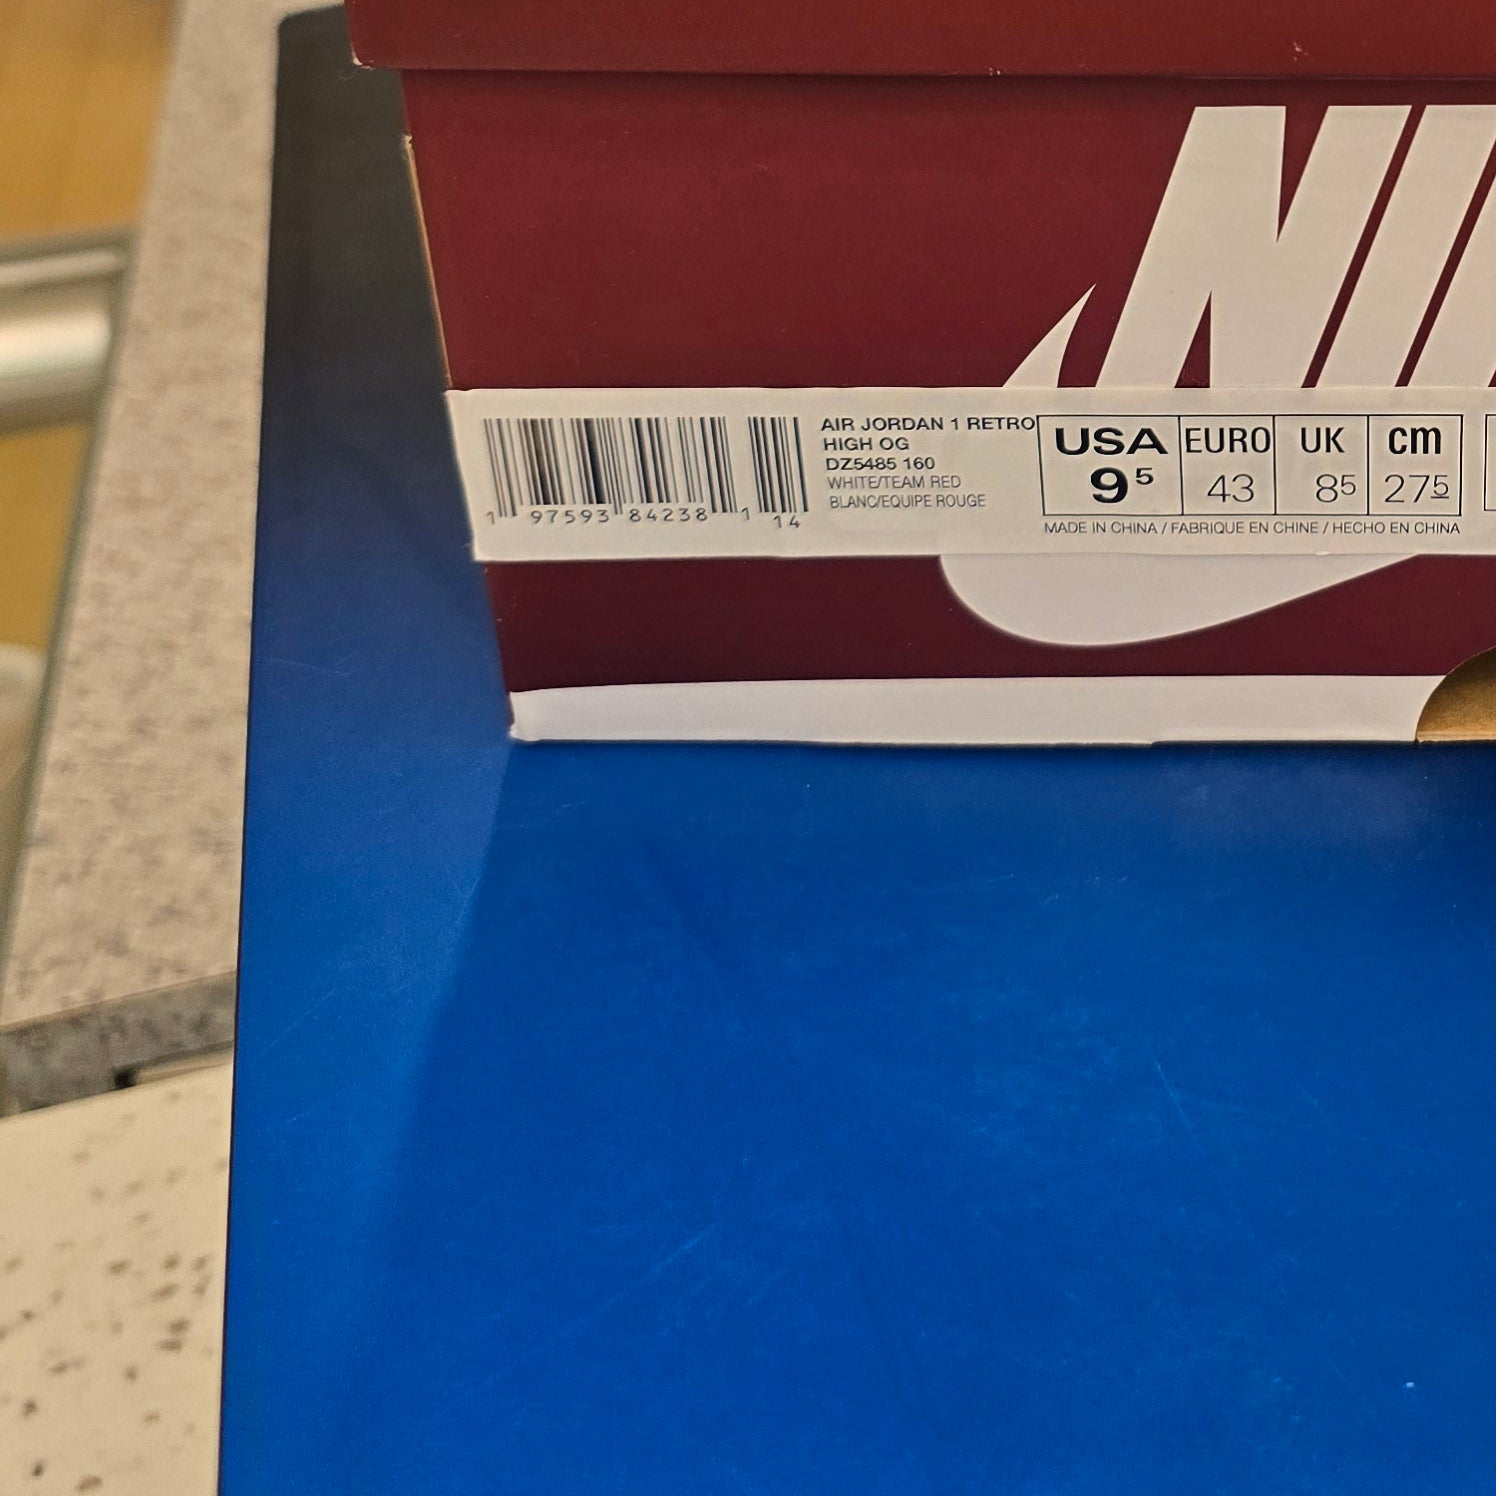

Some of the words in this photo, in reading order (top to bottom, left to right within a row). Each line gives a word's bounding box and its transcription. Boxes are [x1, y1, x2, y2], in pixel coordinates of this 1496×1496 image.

[820, 416, 855, 431] AIR
[861, 416, 944, 431] JORDAN
[950, 416, 960, 431] 1
[966, 416, 1036, 431] RETRO
[823, 436, 873, 451] HIGH
[879, 436, 910, 451] OG
[1055, 426, 1169, 456] USA
[1185, 426, 1271, 454] EURO
[1299, 426, 1346, 454] UK
[1388, 426, 1442, 455] cm
[825, 456, 897, 471] DZ5485
[902, 456, 936, 470] 160
[827, 475, 926, 490] WHITE/TEAM
[930, 475, 962, 489] RED
[1206, 473, 1255, 503] 43
[829, 493, 933, 509] BLANC/EQUIPE
[935, 493, 987, 508] ROUGE
[1044, 521, 1088, 535] MADE
[1092, 521, 1107, 535] IN
[1111, 521, 1159, 535] CHINA
[1171, 521, 1245, 535] FABRIQUE
[1249, 521, 1269, 535] EN
[1273, 521, 1319, 535] CHINE
[1332, 521, 1386, 535] HECHO
[1390, 521, 1409, 535] EN
[1414, 521, 1461, 535] CHINA
